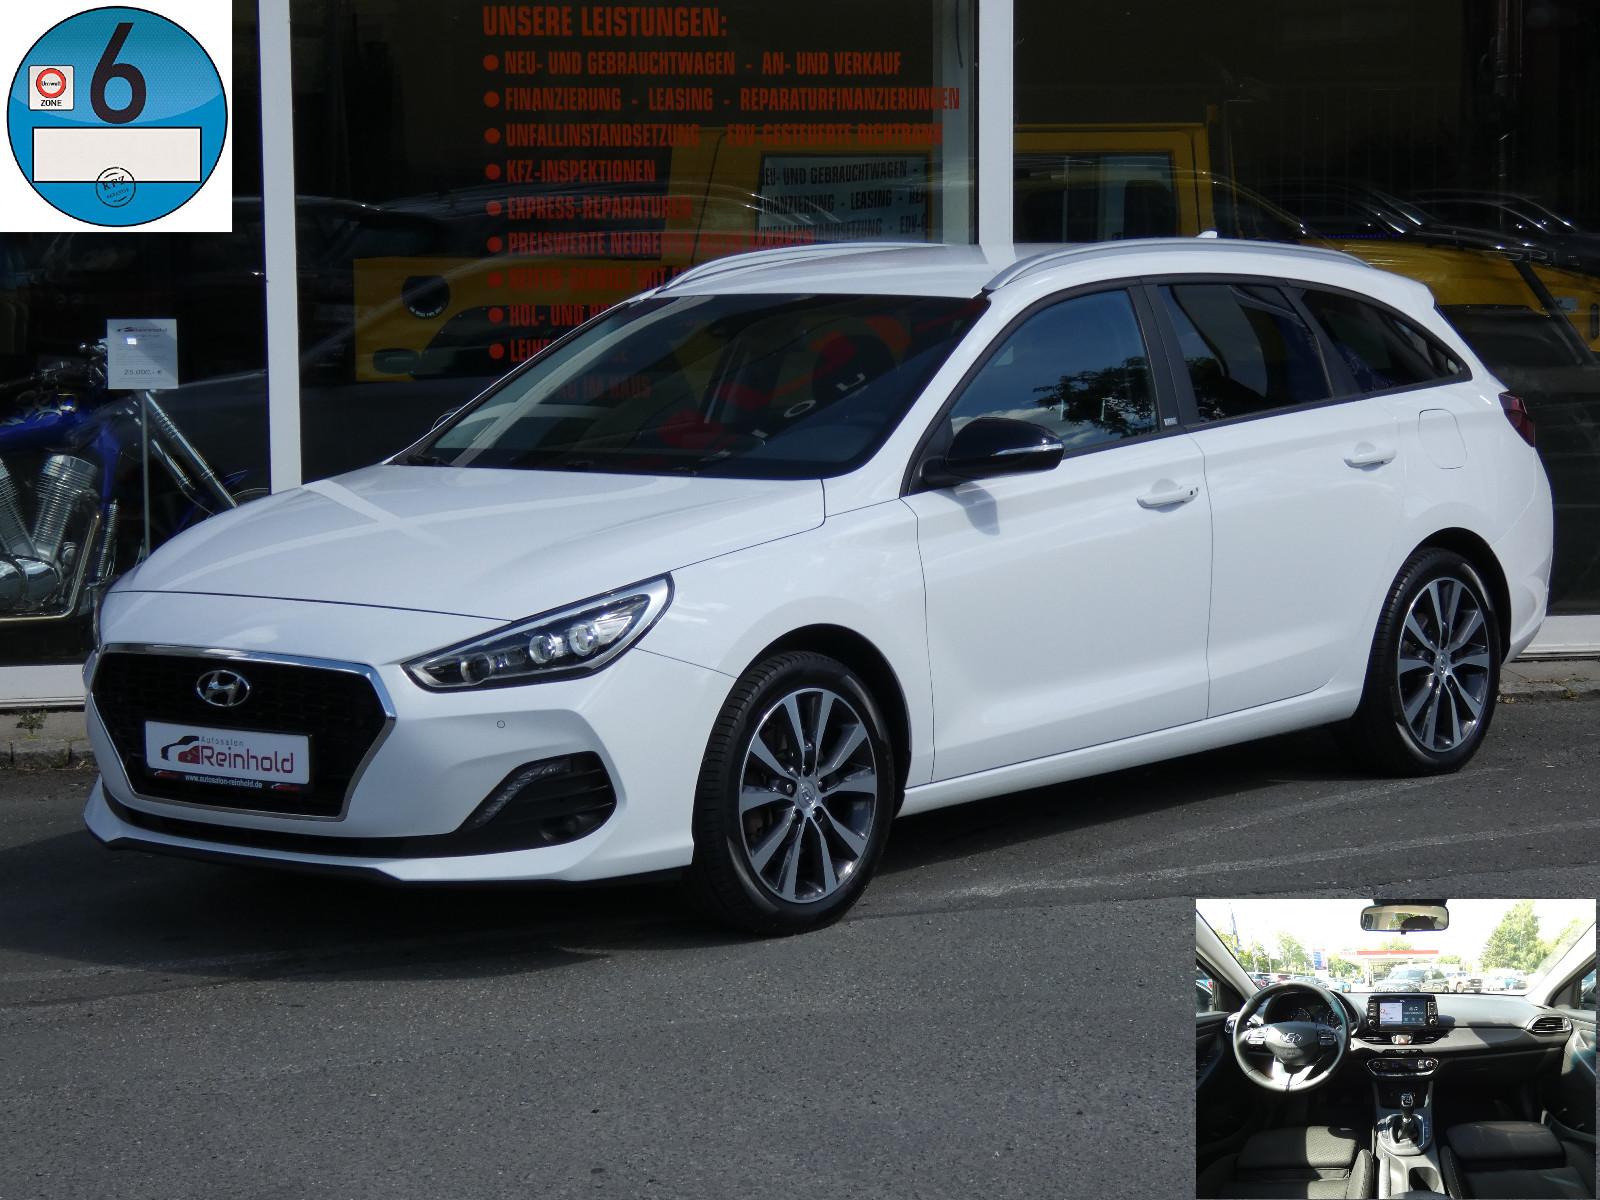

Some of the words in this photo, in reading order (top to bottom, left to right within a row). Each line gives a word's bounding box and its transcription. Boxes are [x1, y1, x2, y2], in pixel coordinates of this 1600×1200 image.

[483, 6, 574, 37] UNSERE
[580, 6, 728, 38] LEISTUNGEN:
[505, 50, 544, 75] NEU-
[547, 50, 582, 76] UND
[586, 51, 737, 76] GEBRAUCHTWAGEN
[762, 51, 791, 75] AN-
[796, 51, 829, 75] UND
[834, 51, 902, 75] VERKAUF
[505, 87, 622, 112] FINANZIERUNG
[647, 87, 714, 112] LEASING
[740, 87, 961, 112] REPARATURFINANZIERUNGEN
[506, 123, 701, 148] UNFALLINSTANDSETZUNG
[507, 159, 657, 184] KFZ-INSPEKTIONEN
[783, 167, 807, 186] UND
[810, 160, 909, 186] GEBRAUCHTWAGEN
[850, 190, 893, 211] LEASING
[507, 231, 606, 256] PREISWERTE
[508, 303, 545, 328] HOL-
[201, 735, 246, 748] Autosalon
[200, 745, 294, 774] Reinhold
[184, 775, 263, 789] www.autosalon-reinhold.de
